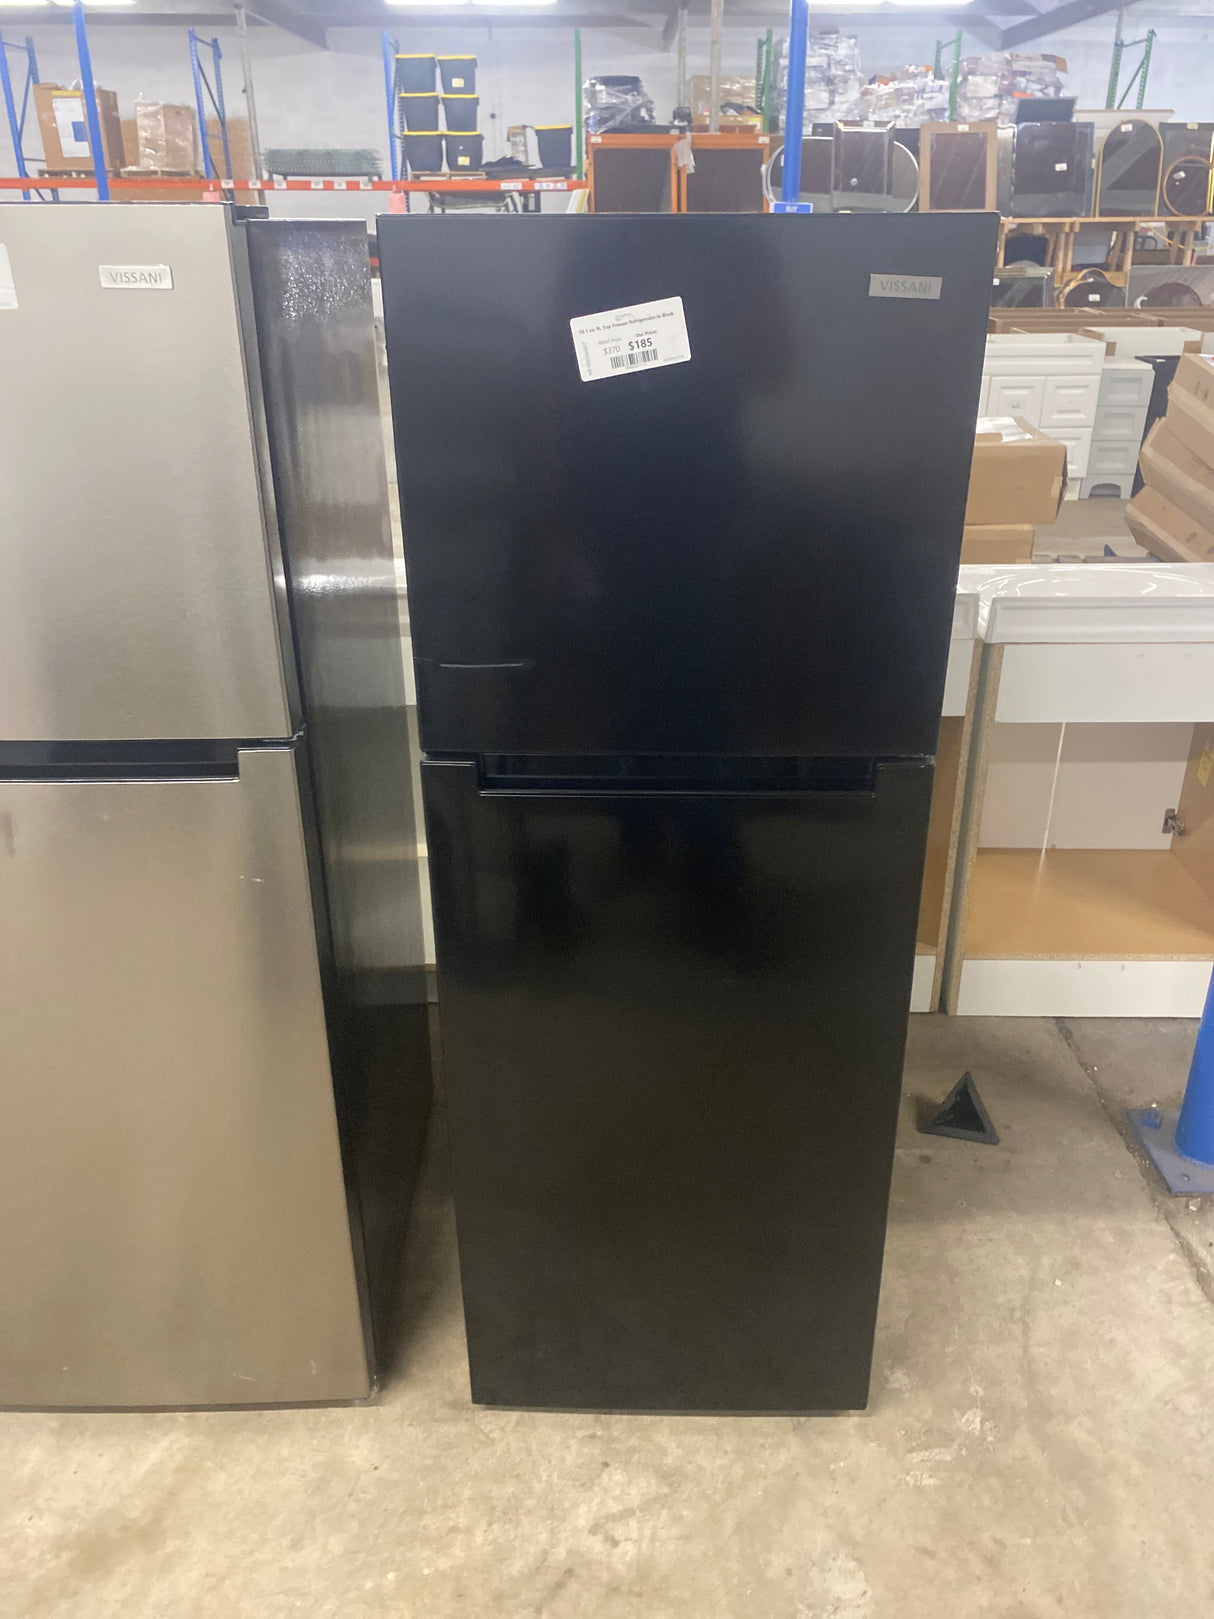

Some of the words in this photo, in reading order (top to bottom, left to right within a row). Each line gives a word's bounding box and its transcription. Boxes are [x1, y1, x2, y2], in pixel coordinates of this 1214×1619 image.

[109, 271, 162, 284] VISSANI
[880, 280, 932, 293] VISSANI
[603, 345, 621, 355] $370
[628, 337, 653, 350] $185
